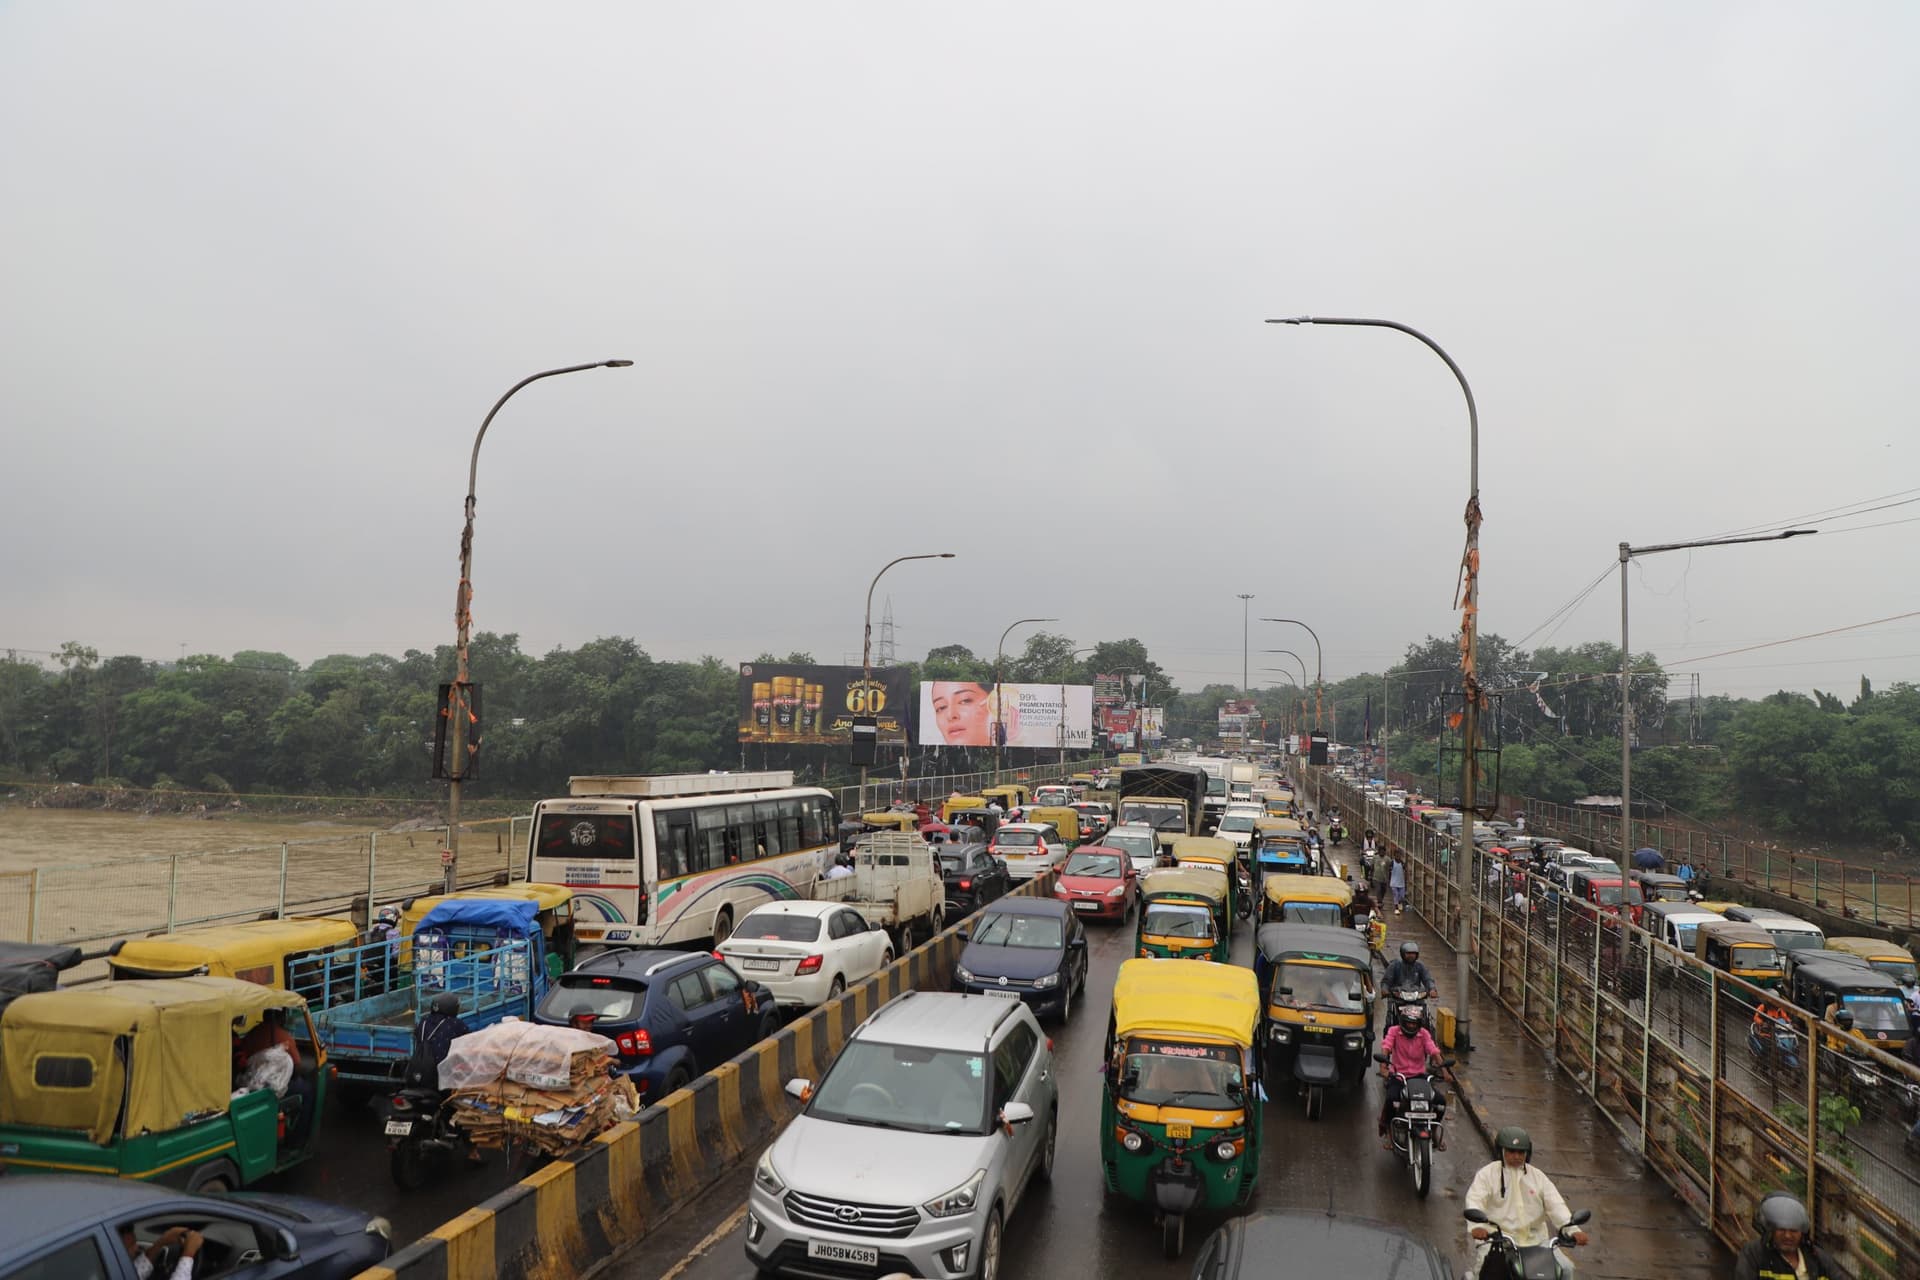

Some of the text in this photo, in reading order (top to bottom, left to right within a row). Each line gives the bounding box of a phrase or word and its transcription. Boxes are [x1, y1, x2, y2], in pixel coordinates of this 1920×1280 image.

[846, 689, 885, 713] 60
[1019, 693, 1036, 701] 99%
[815, 1244, 876, 1263] JH05BW4589
